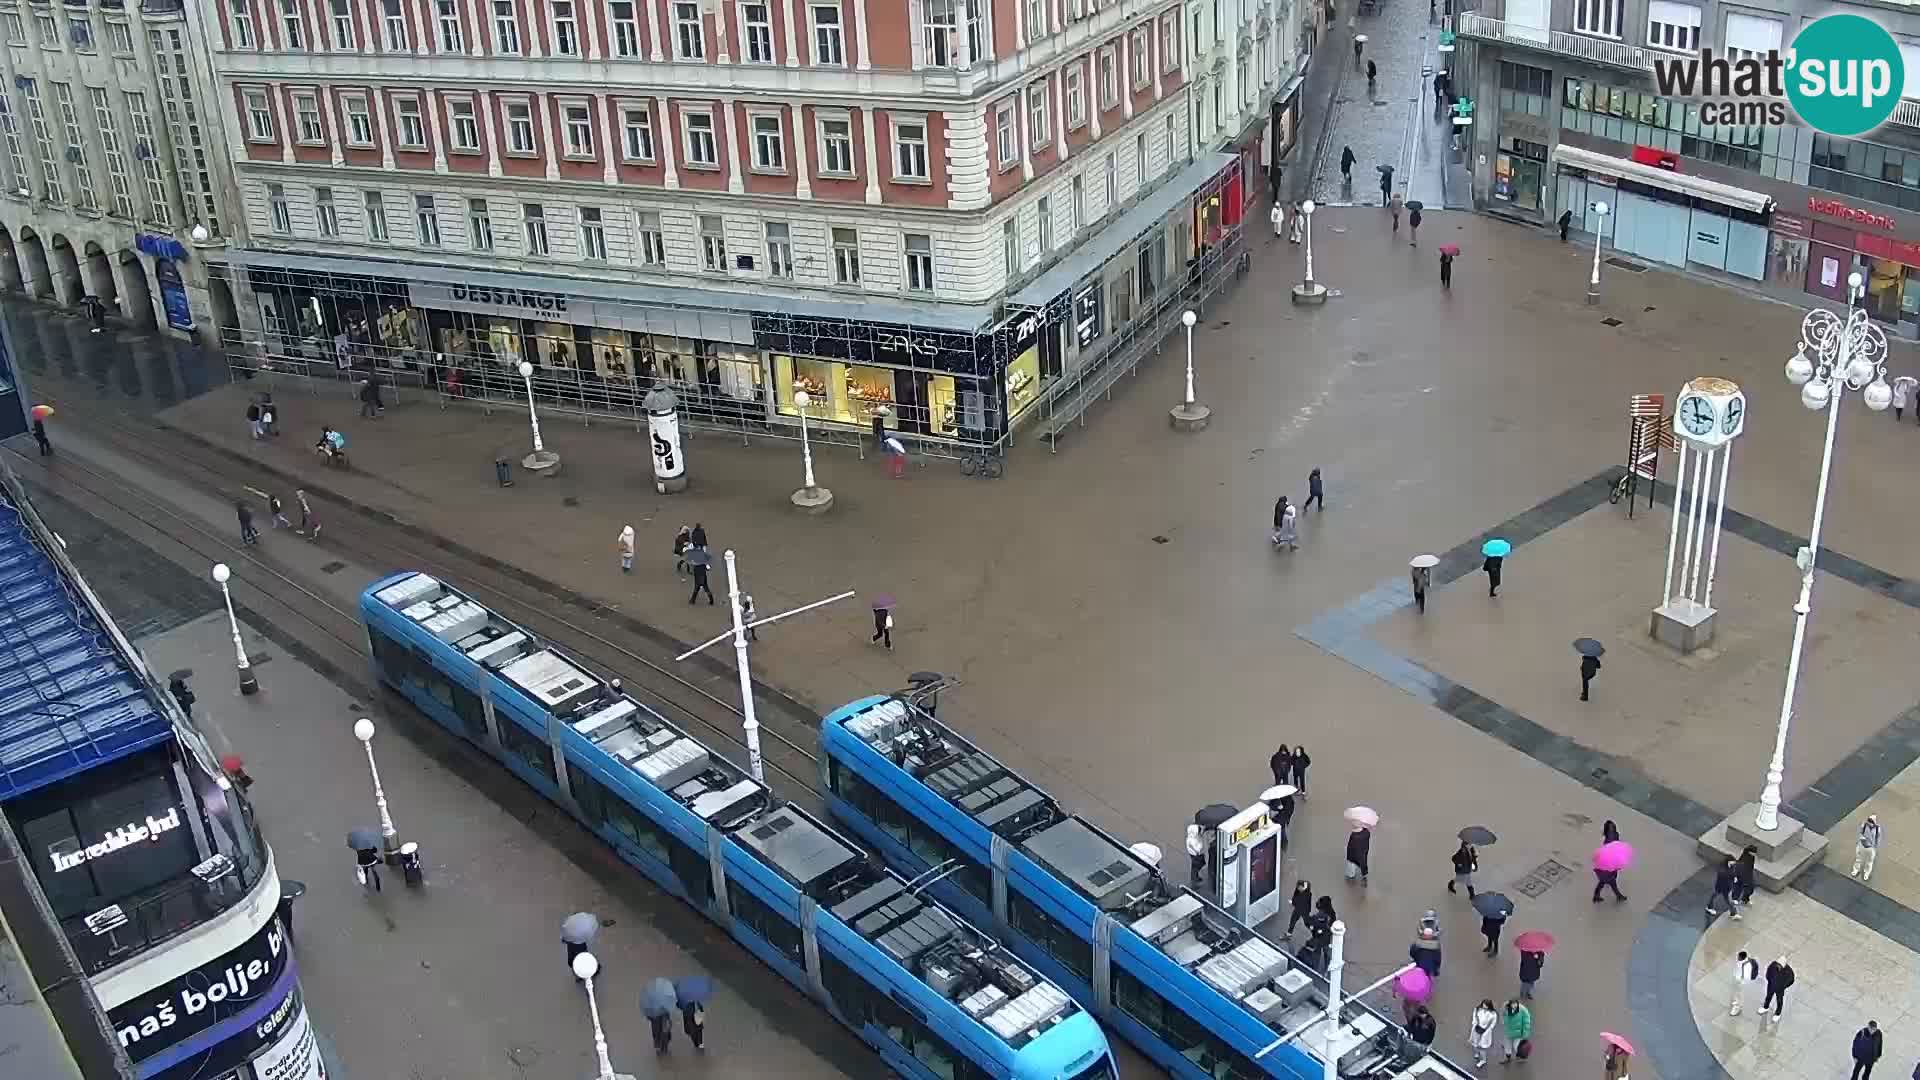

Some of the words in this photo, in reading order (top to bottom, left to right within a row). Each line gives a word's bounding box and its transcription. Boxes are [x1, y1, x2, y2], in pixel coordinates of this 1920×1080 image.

[877, 333, 939, 356] ZAKS
[117, 1000, 177, 1048] naš
[182, 959, 270, 1015] bolje,
